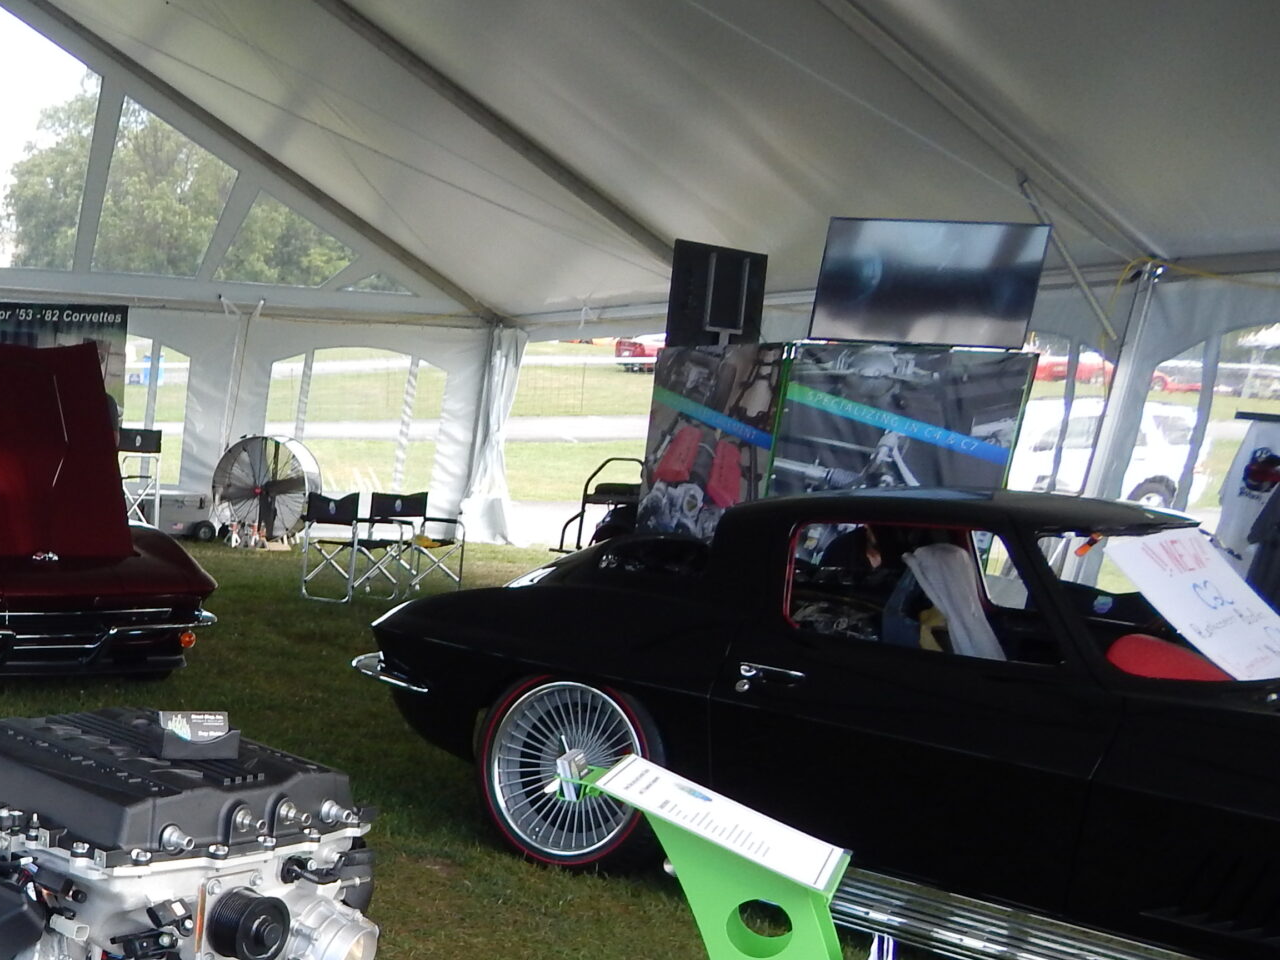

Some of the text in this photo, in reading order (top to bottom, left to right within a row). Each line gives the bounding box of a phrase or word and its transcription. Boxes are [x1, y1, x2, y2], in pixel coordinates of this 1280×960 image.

[16, 309, 33, 321] '53
[63, 310, 122, 323] Corvettes
[807, 391, 899, 428] SPECIALIZING
[904, 421, 918, 433] IN
